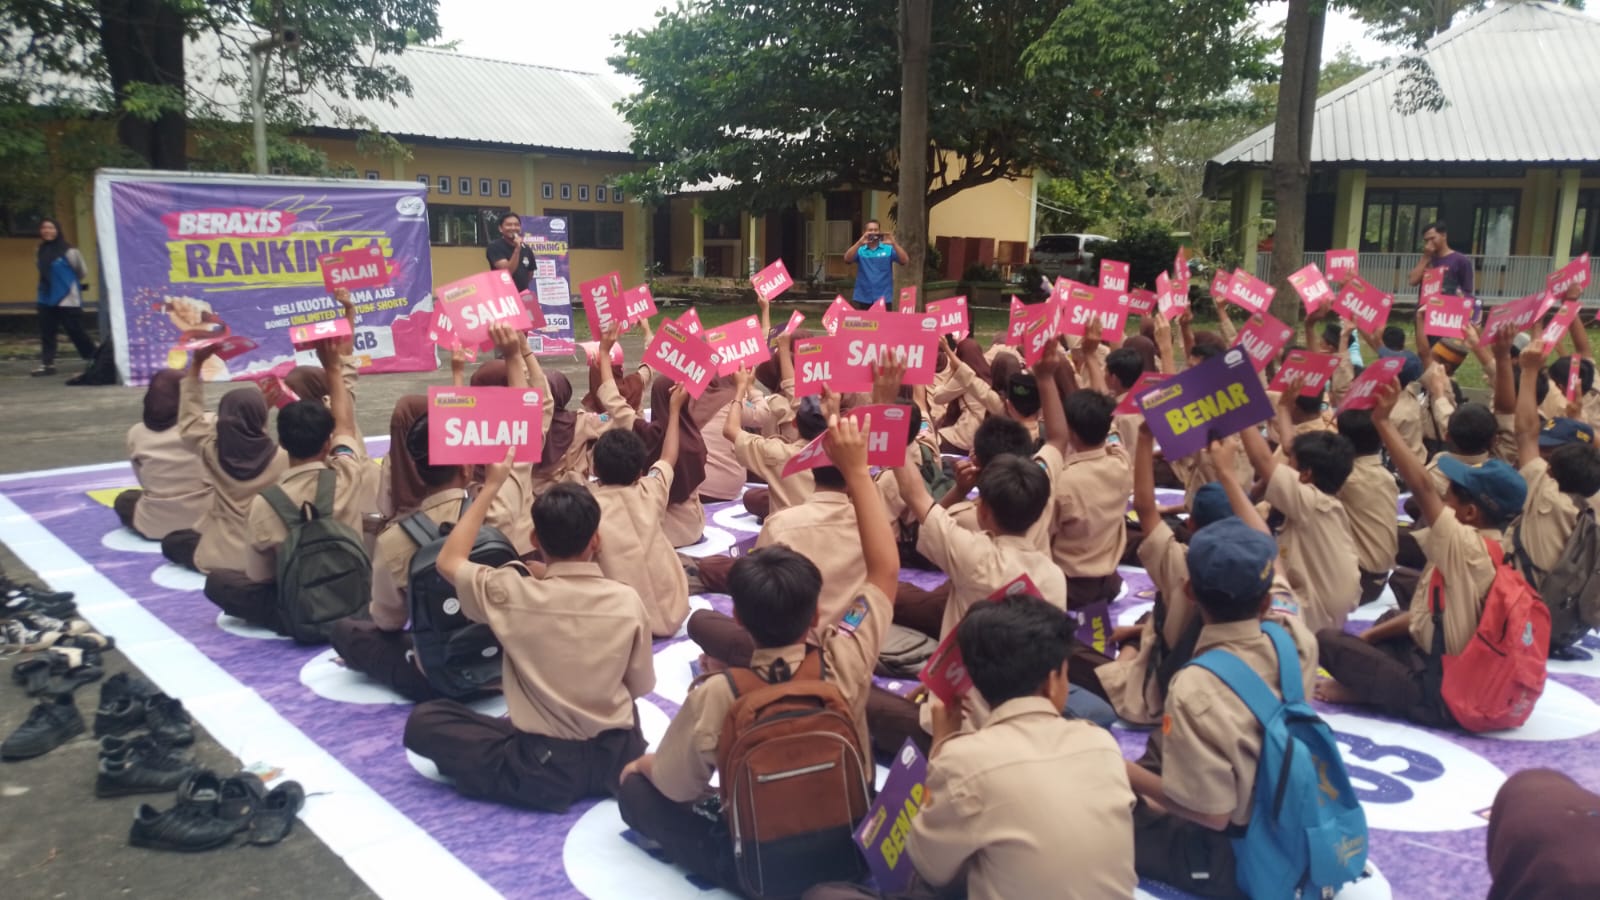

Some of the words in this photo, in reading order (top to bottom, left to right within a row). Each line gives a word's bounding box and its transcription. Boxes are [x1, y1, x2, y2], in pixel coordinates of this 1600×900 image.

[178, 211, 282, 235] BERAXIS
[331, 264, 378, 284] SALAH
[759, 272, 786, 296] SALAH
[1103, 275, 1125, 291] SALAH
[273, 302, 296, 316] BELI
[297, 296, 334, 312] KUOTA
[375, 287, 395, 300] AXIS
[1232, 283, 1264, 308] SALAH
[1342, 292, 1378, 323] SALAH
[290, 310, 336, 326] UNLIMITED
[376, 297, 409, 311] SHORTS
[461, 296, 520, 330] SALAH
[940, 312, 962, 327] LAH
[1430, 310, 1463, 329] SALAH
[656, 341, 706, 385] SALAH
[718, 337, 760, 365] SALAH
[803, 361, 832, 383] SAL
[1165, 383, 1250, 435] BENAR
[444, 417, 528, 446] SALAH
